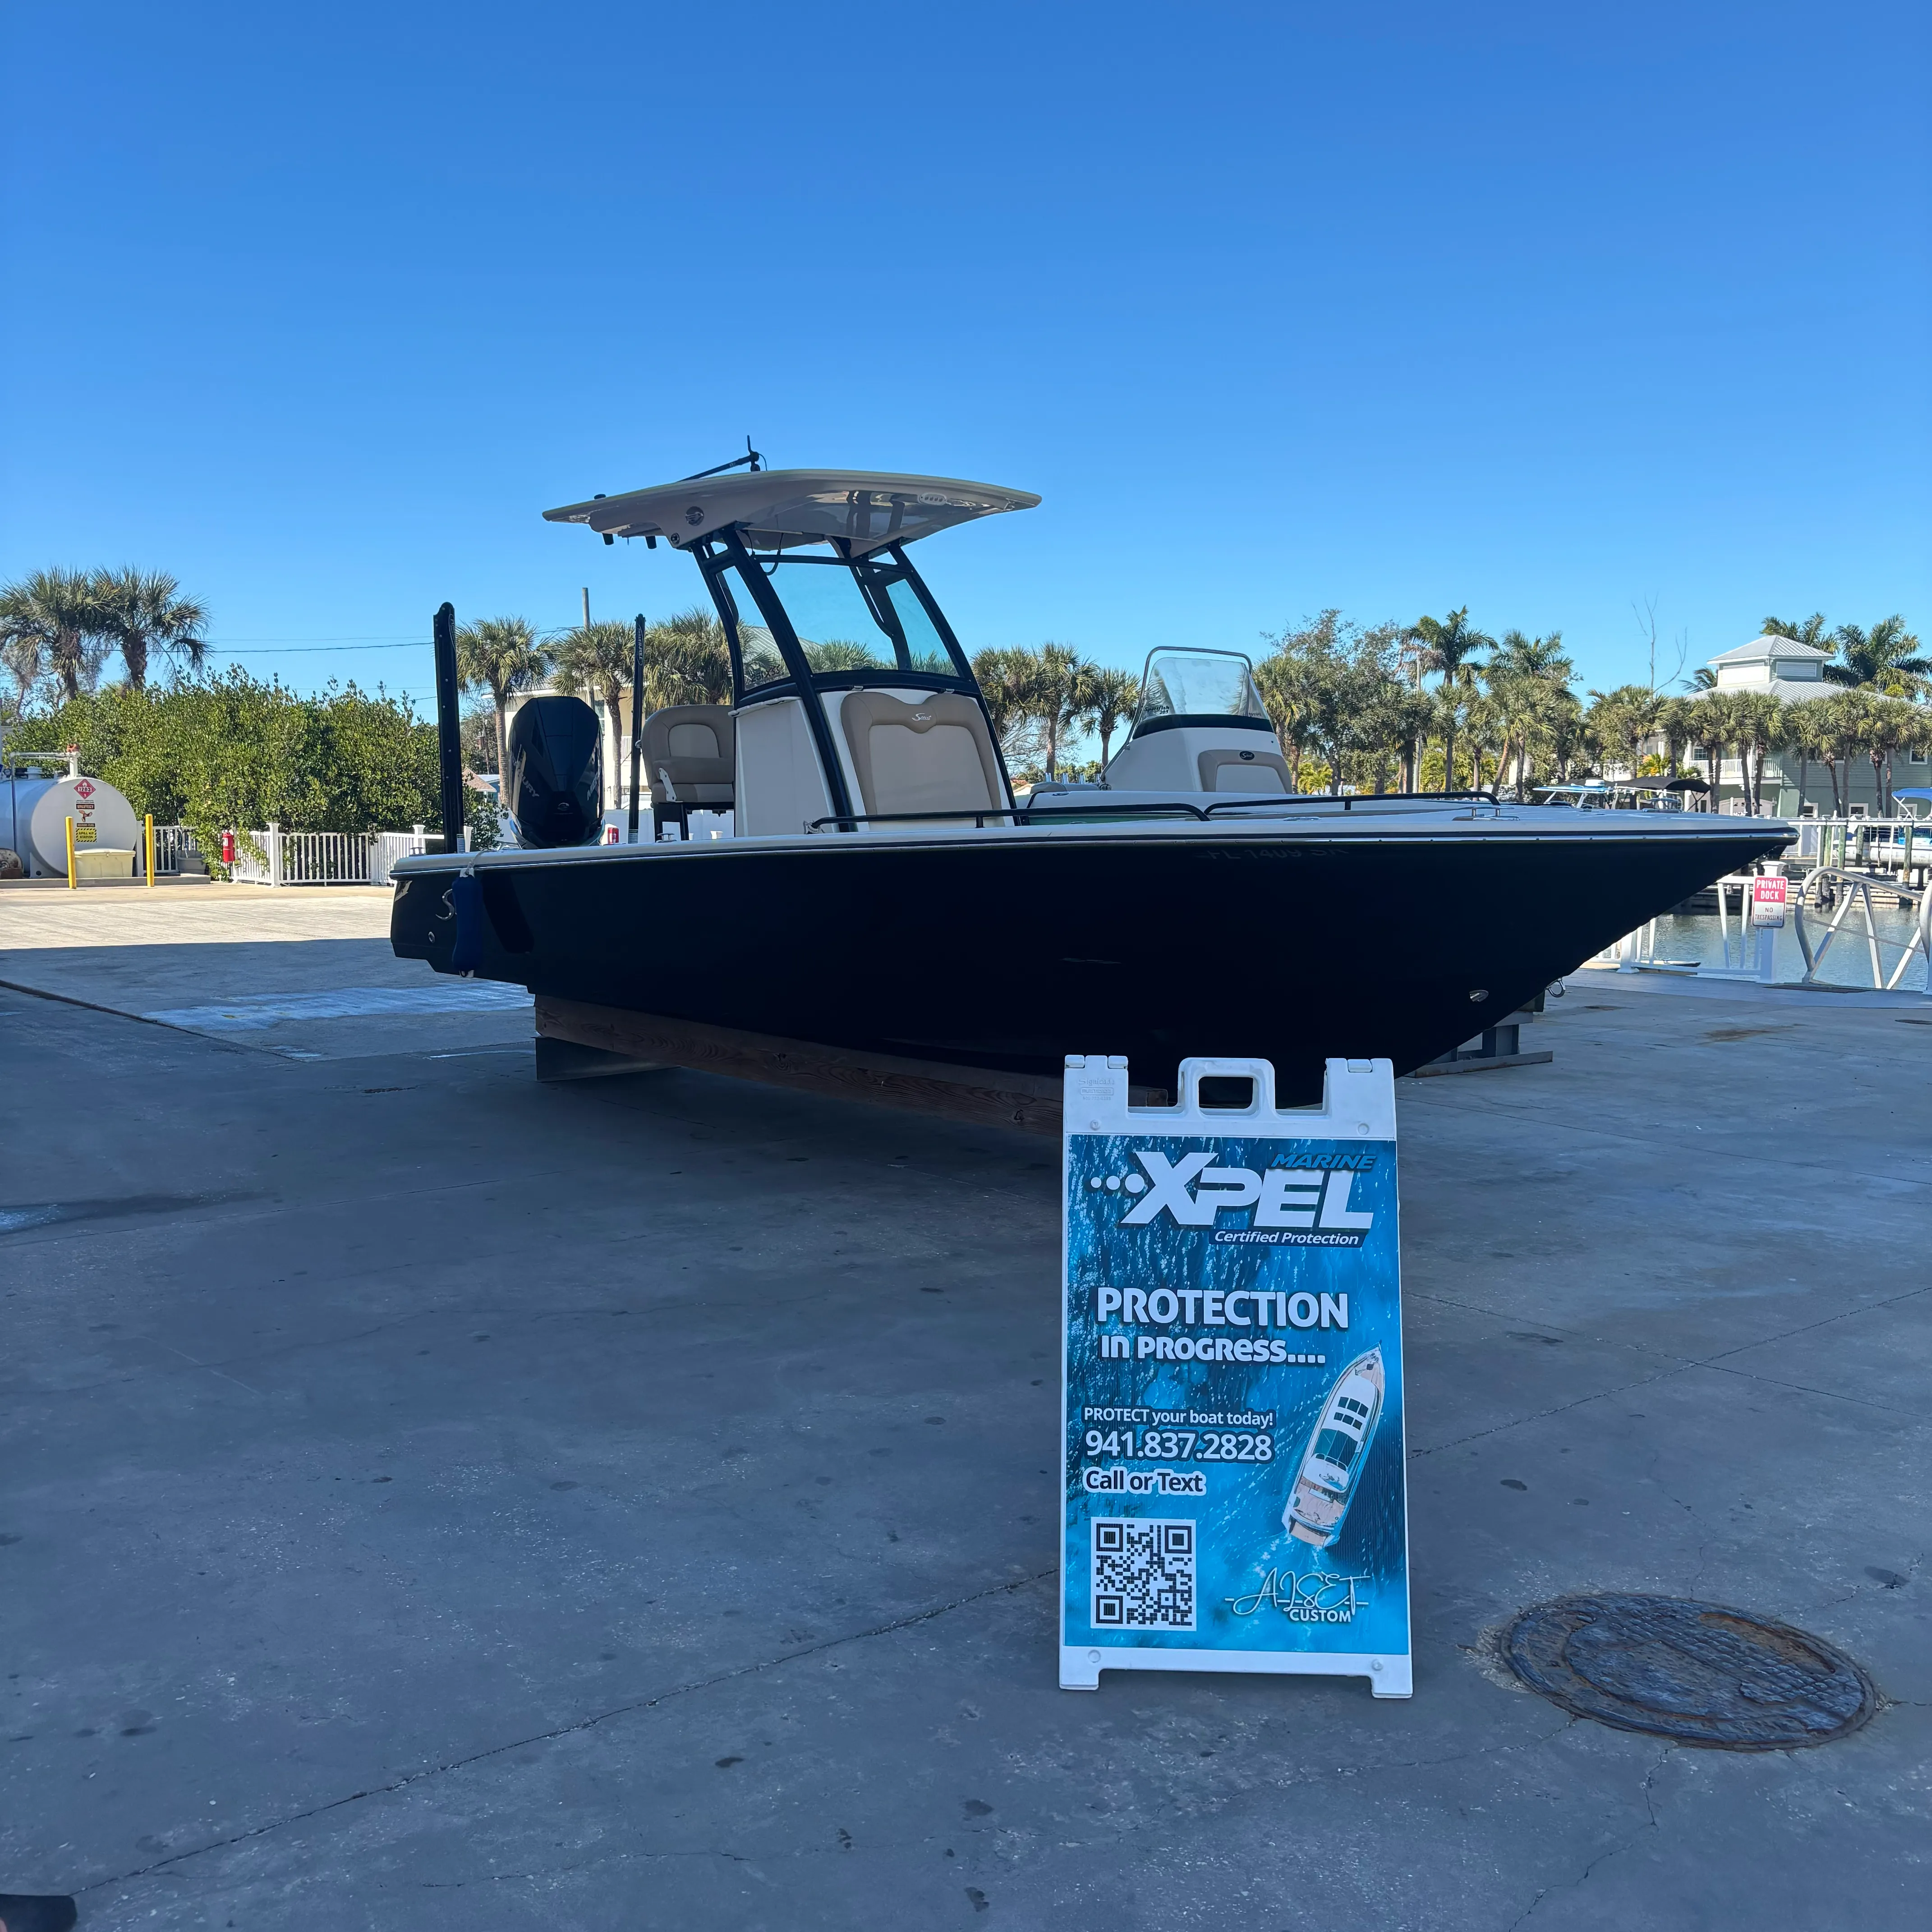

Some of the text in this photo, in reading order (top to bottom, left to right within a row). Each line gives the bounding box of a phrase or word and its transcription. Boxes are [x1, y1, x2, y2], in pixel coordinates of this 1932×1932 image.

[1757, 879, 1785, 890] PRIVATE
[1760, 890, 1779, 900] DOCK
[1271, 1154, 1375, 1169] MARINE
[1120, 1151, 1374, 1229] XPEL
[1215, 1231, 1359, 1245] Certified Protection
[1098, 1287, 1348, 1328] PROTECTION
[1084, 1408, 1274, 1429] PROTECT your boat today!
[1086, 1431, 1272, 1460] 941.837.2828
[1086, 1470, 1203, 1492] Call or Text
[1289, 1609, 1351, 1623] CUSTOM
